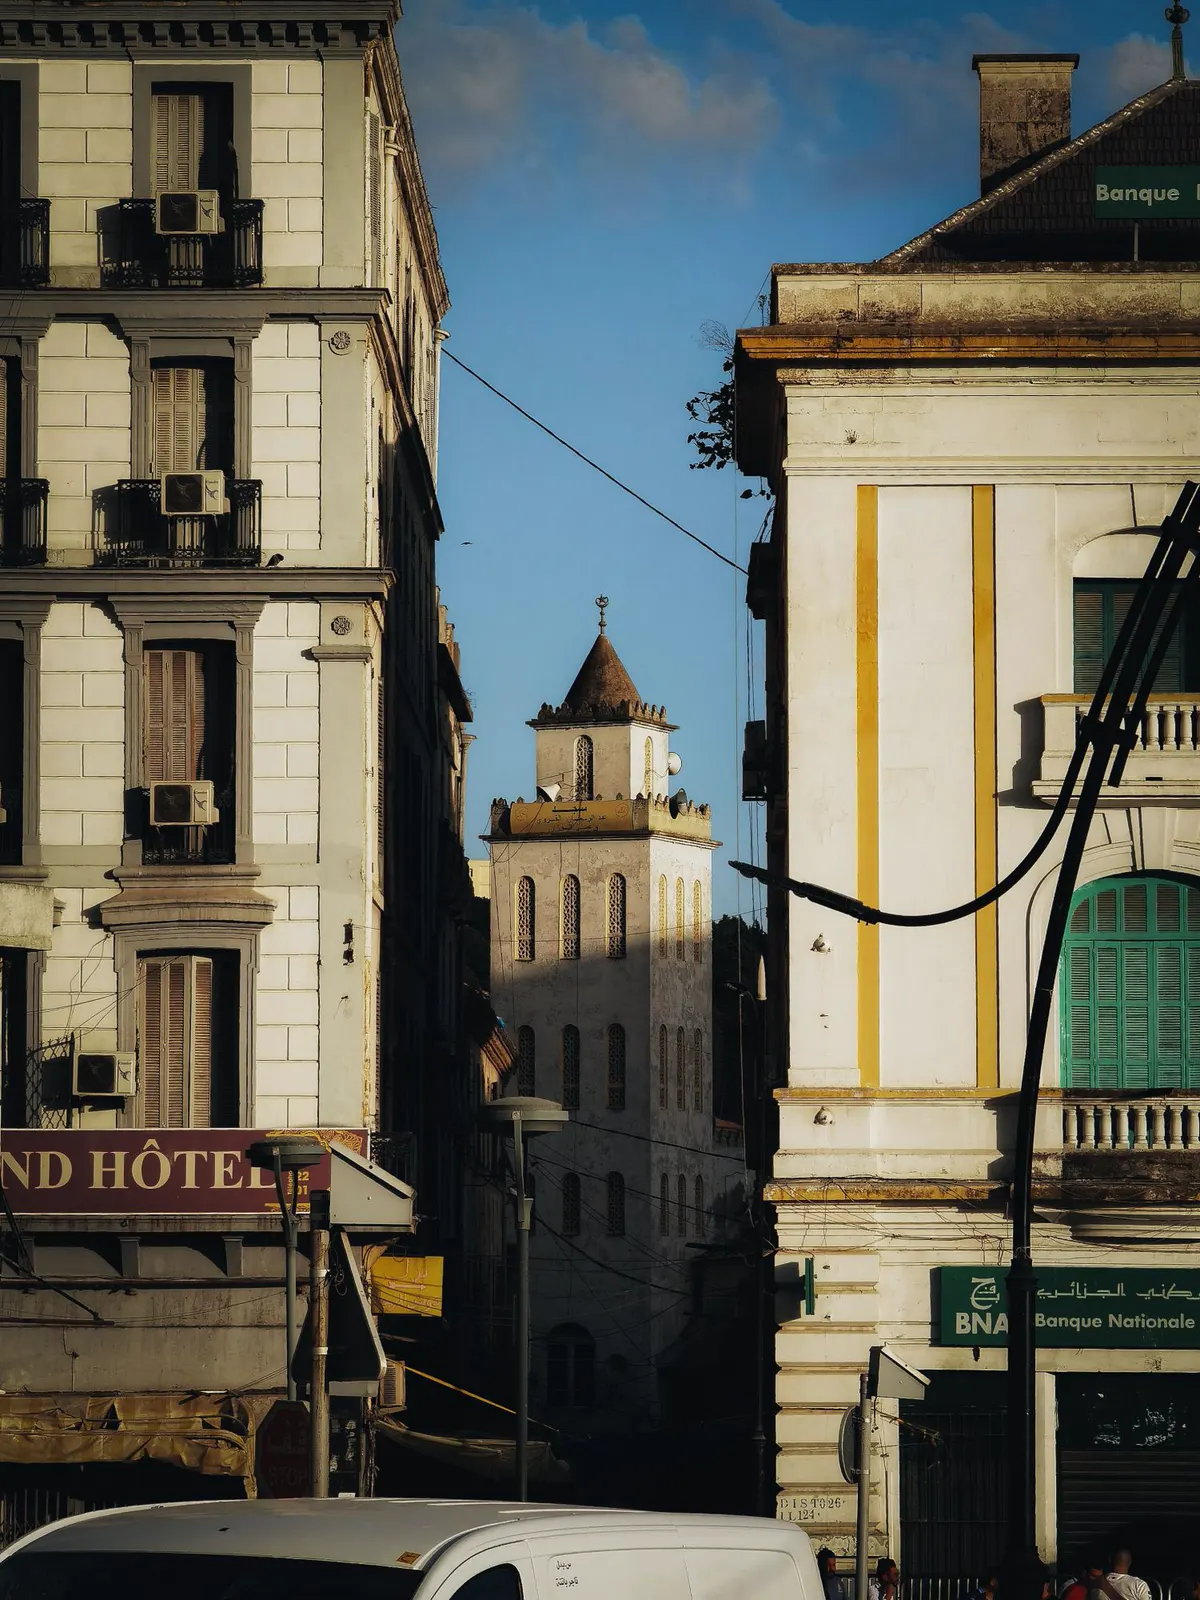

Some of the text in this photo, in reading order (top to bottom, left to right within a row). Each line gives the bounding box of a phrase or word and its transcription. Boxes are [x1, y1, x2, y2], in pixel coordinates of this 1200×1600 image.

[1096, 184, 1180, 207] Banque
[88, 1138, 276, 1190] HÔTEL
[1036, 1281, 1126, 1300] الجزائري
[955, 1312, 1009, 1335] BNA
[1035, 1312, 1195, 1332] Banque Nationale
